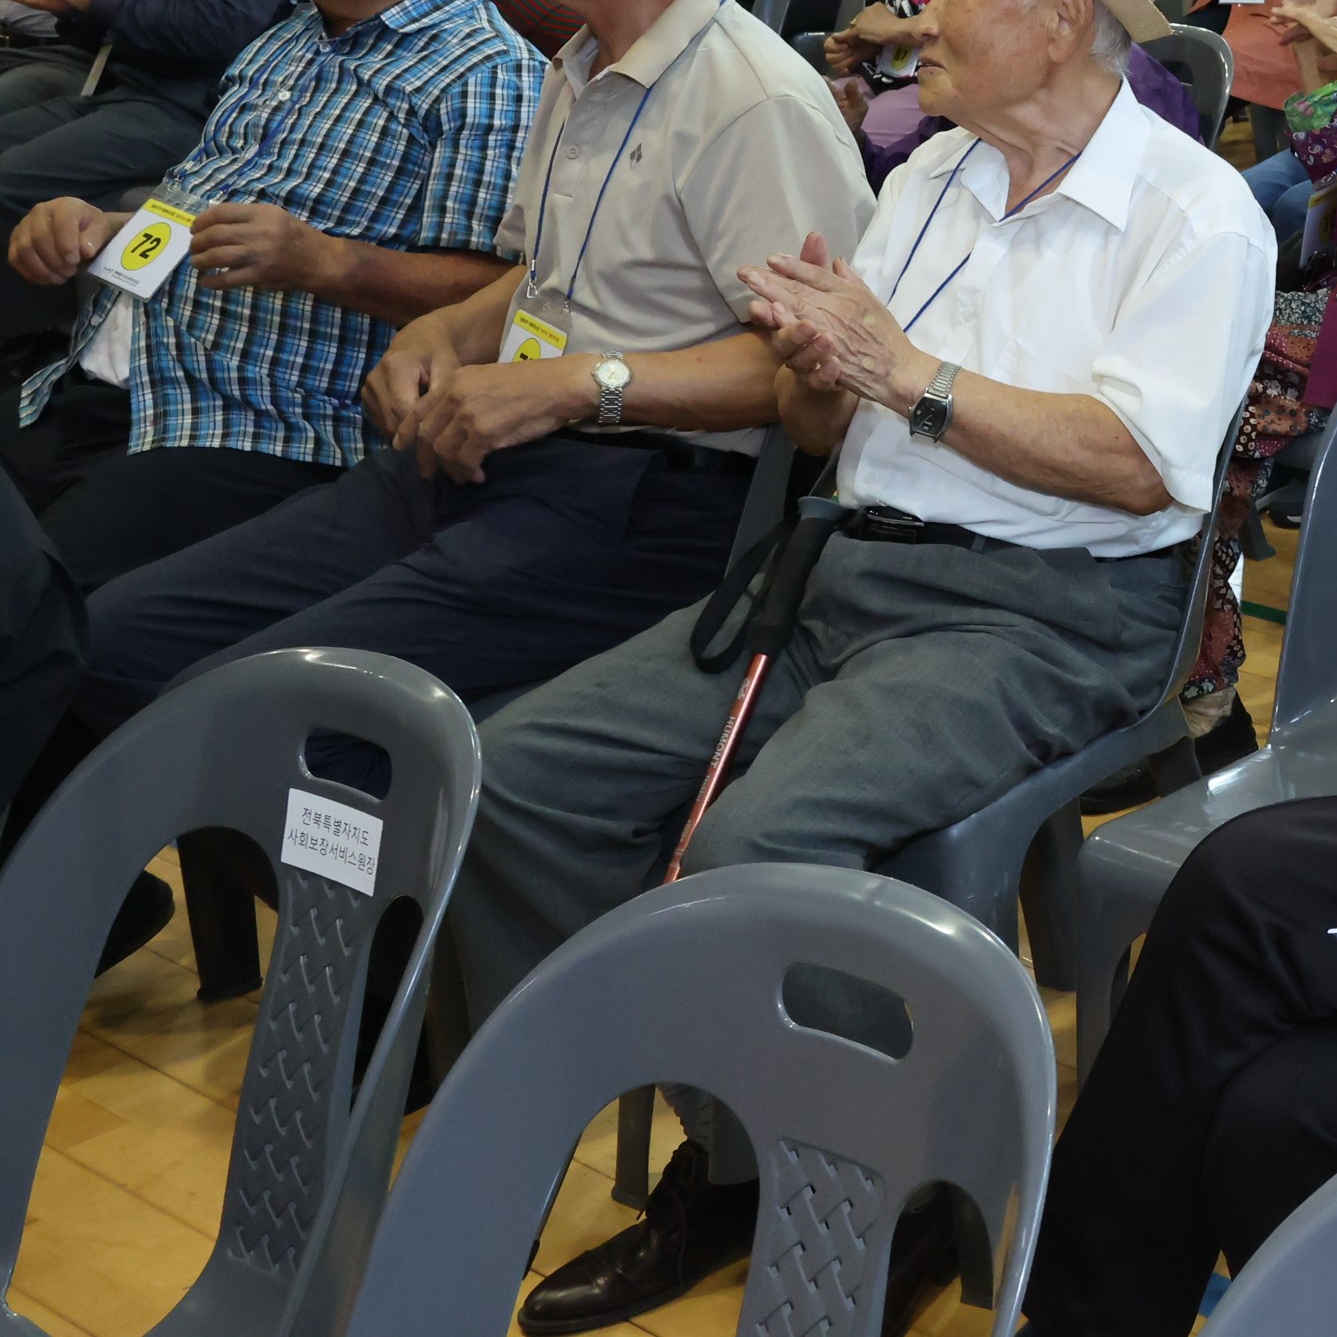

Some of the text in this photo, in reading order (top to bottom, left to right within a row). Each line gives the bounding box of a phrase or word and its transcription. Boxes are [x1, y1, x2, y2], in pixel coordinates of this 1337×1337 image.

[131, 232, 162, 259] 72
[710, 715, 736, 769] HUMONT
[302, 807, 369, 846] 전북특별자치도
[287, 828, 376, 875] 사회보장서비스원장
